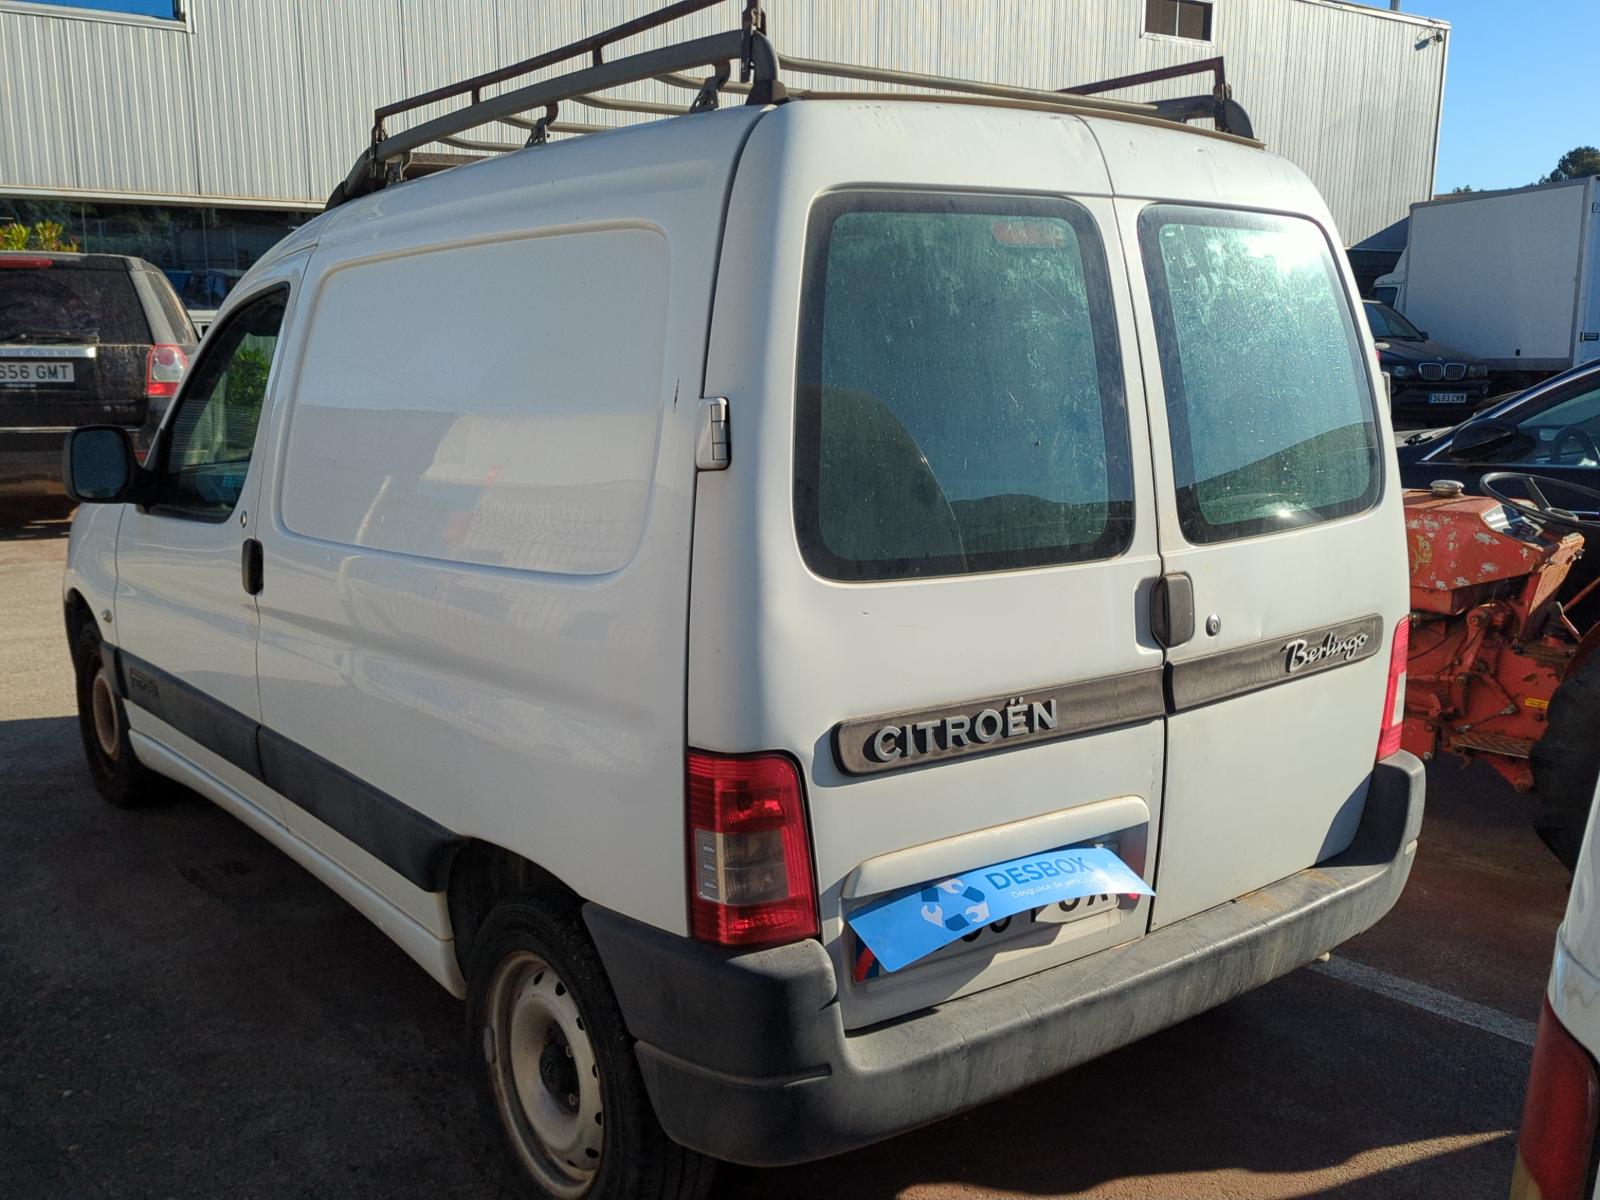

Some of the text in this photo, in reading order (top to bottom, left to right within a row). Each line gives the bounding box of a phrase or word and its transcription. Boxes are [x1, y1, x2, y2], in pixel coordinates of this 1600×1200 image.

[36, 365, 69, 379] GMT
[1284, 632, 1368, 672] Berlingo
[872, 696, 1058, 762] CITROËN
[985, 857, 1095, 890] DESBOX
